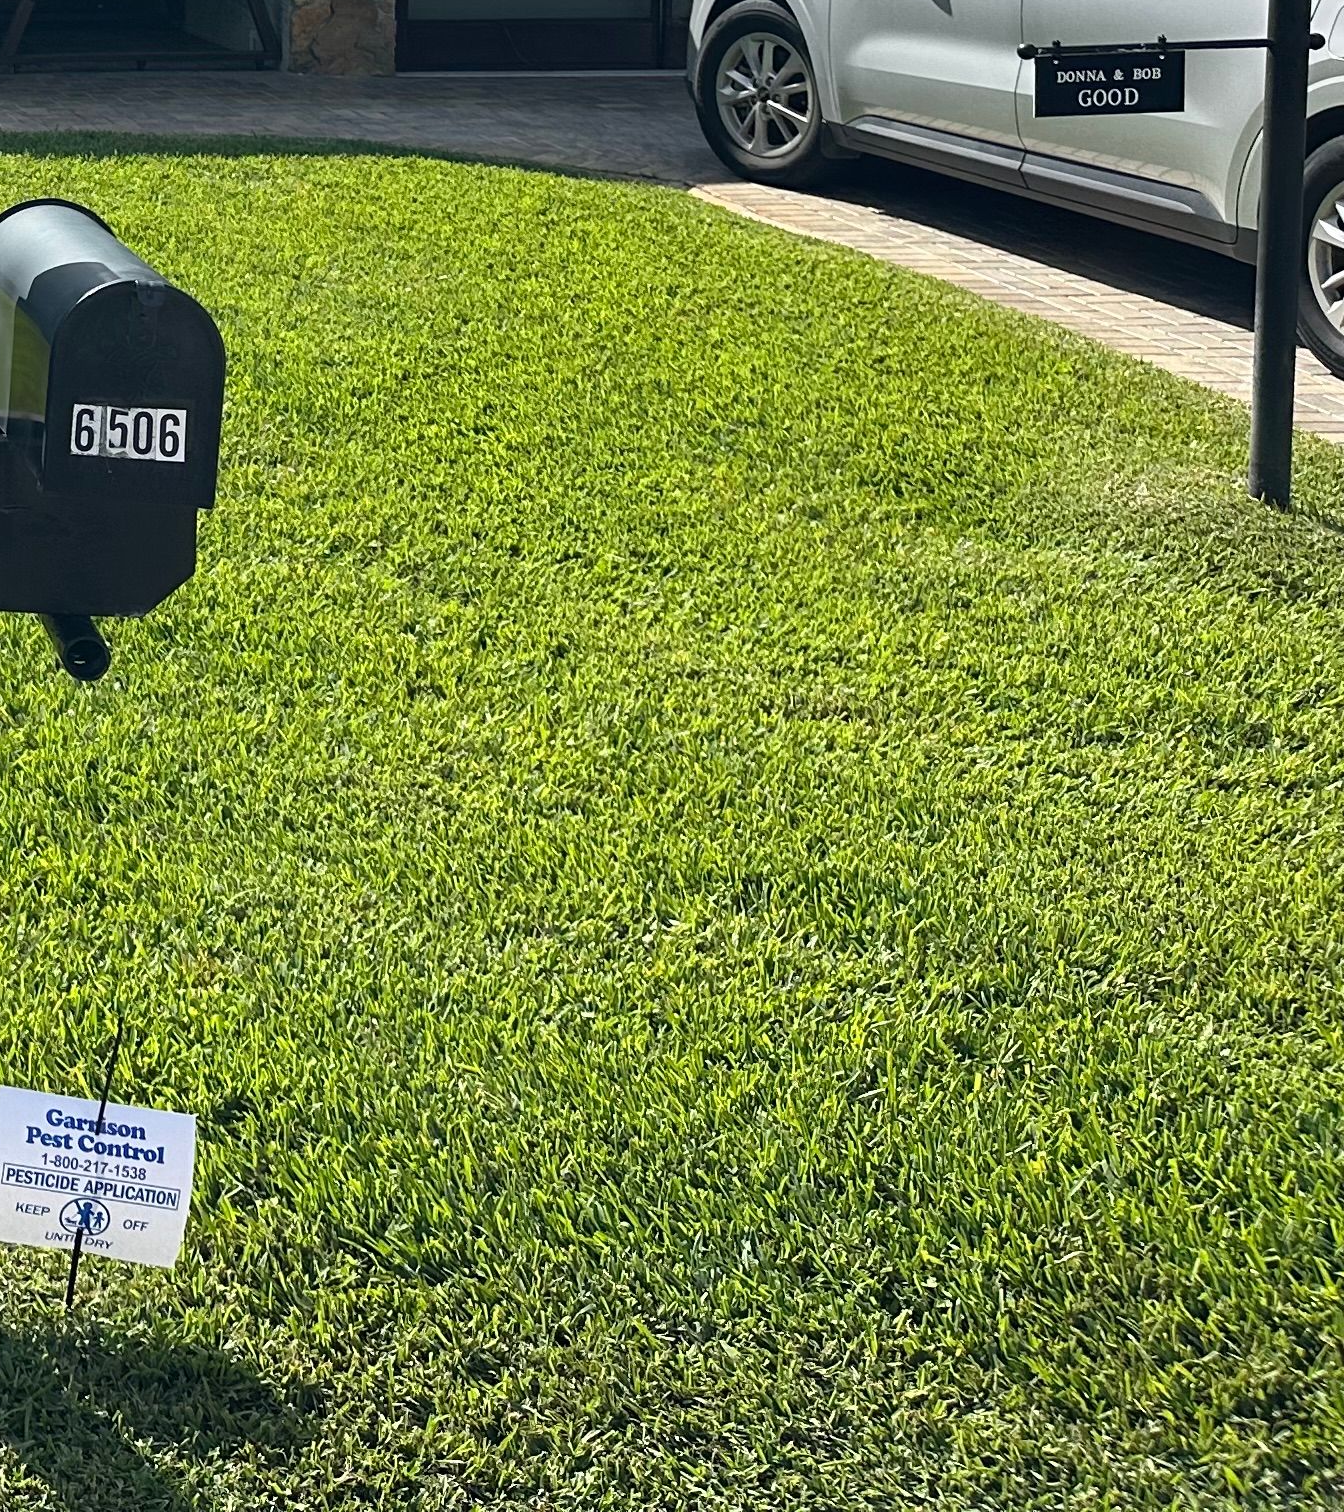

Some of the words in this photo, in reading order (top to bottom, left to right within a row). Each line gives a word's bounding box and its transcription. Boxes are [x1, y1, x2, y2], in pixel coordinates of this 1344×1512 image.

[1056, 69, 1107, 84] DONNA
[1113, 69, 1124, 81] &
[1133, 67, 1162, 80] BOB
[1078, 87, 1139, 108] GOOD
[74, 408, 180, 458] 6506
[25, 1125, 73, 1149] Pest
[78, 1134, 165, 1164] Control
[41, 1152, 147, 1181] 1-800-217-1538
[6, 1167, 80, 1192] PESTICIDE
[83, 1179, 178, 1207] APPLICATION
[15, 1202, 51, 1216] KEEP
[123, 1219, 149, 1231] OFF
[44, 1231, 79, 1243] UNTI
[84, 1236, 113, 1249] DRY
